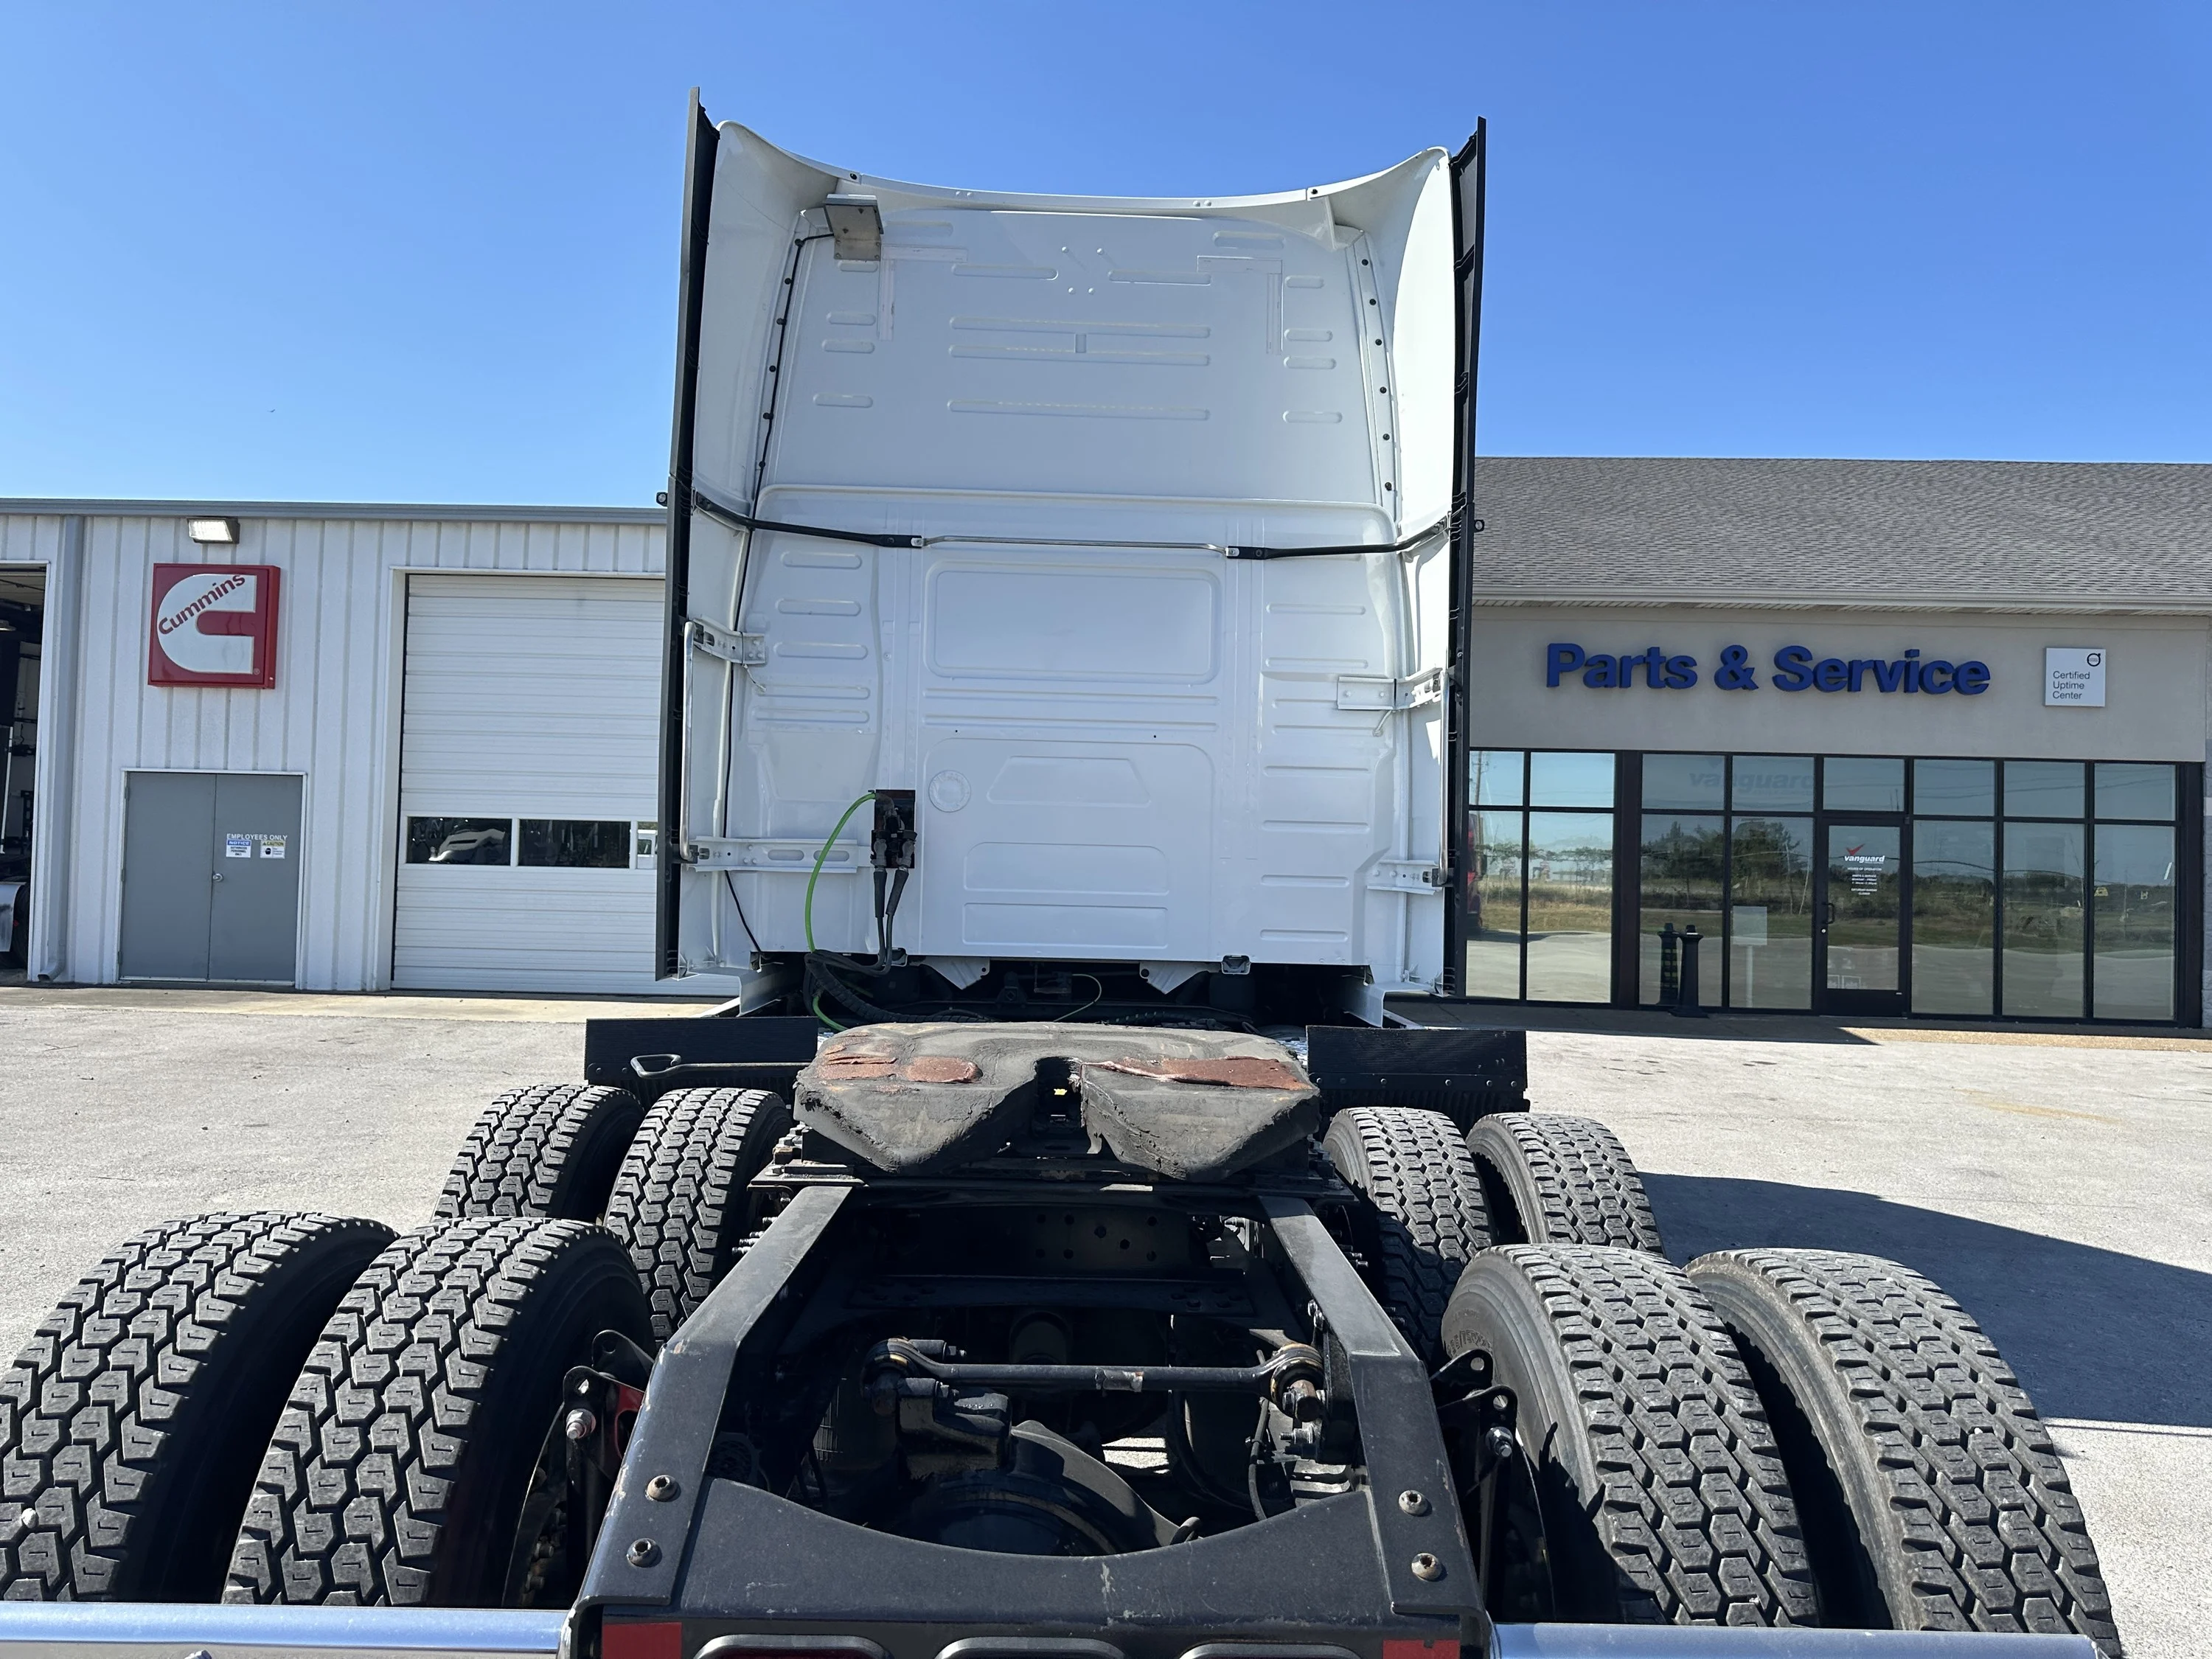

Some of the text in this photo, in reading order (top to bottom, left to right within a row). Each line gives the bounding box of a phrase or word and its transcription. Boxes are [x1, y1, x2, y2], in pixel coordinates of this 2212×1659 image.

[159, 575, 246, 634] Cummins
[1546, 643, 1991, 695] Parts & Service
[2053, 670, 2090, 679] Certified
[2053, 681, 2084, 690] Uptime
[2053, 691, 2082, 699] Center
[1844, 855, 1885, 863] vanguard
